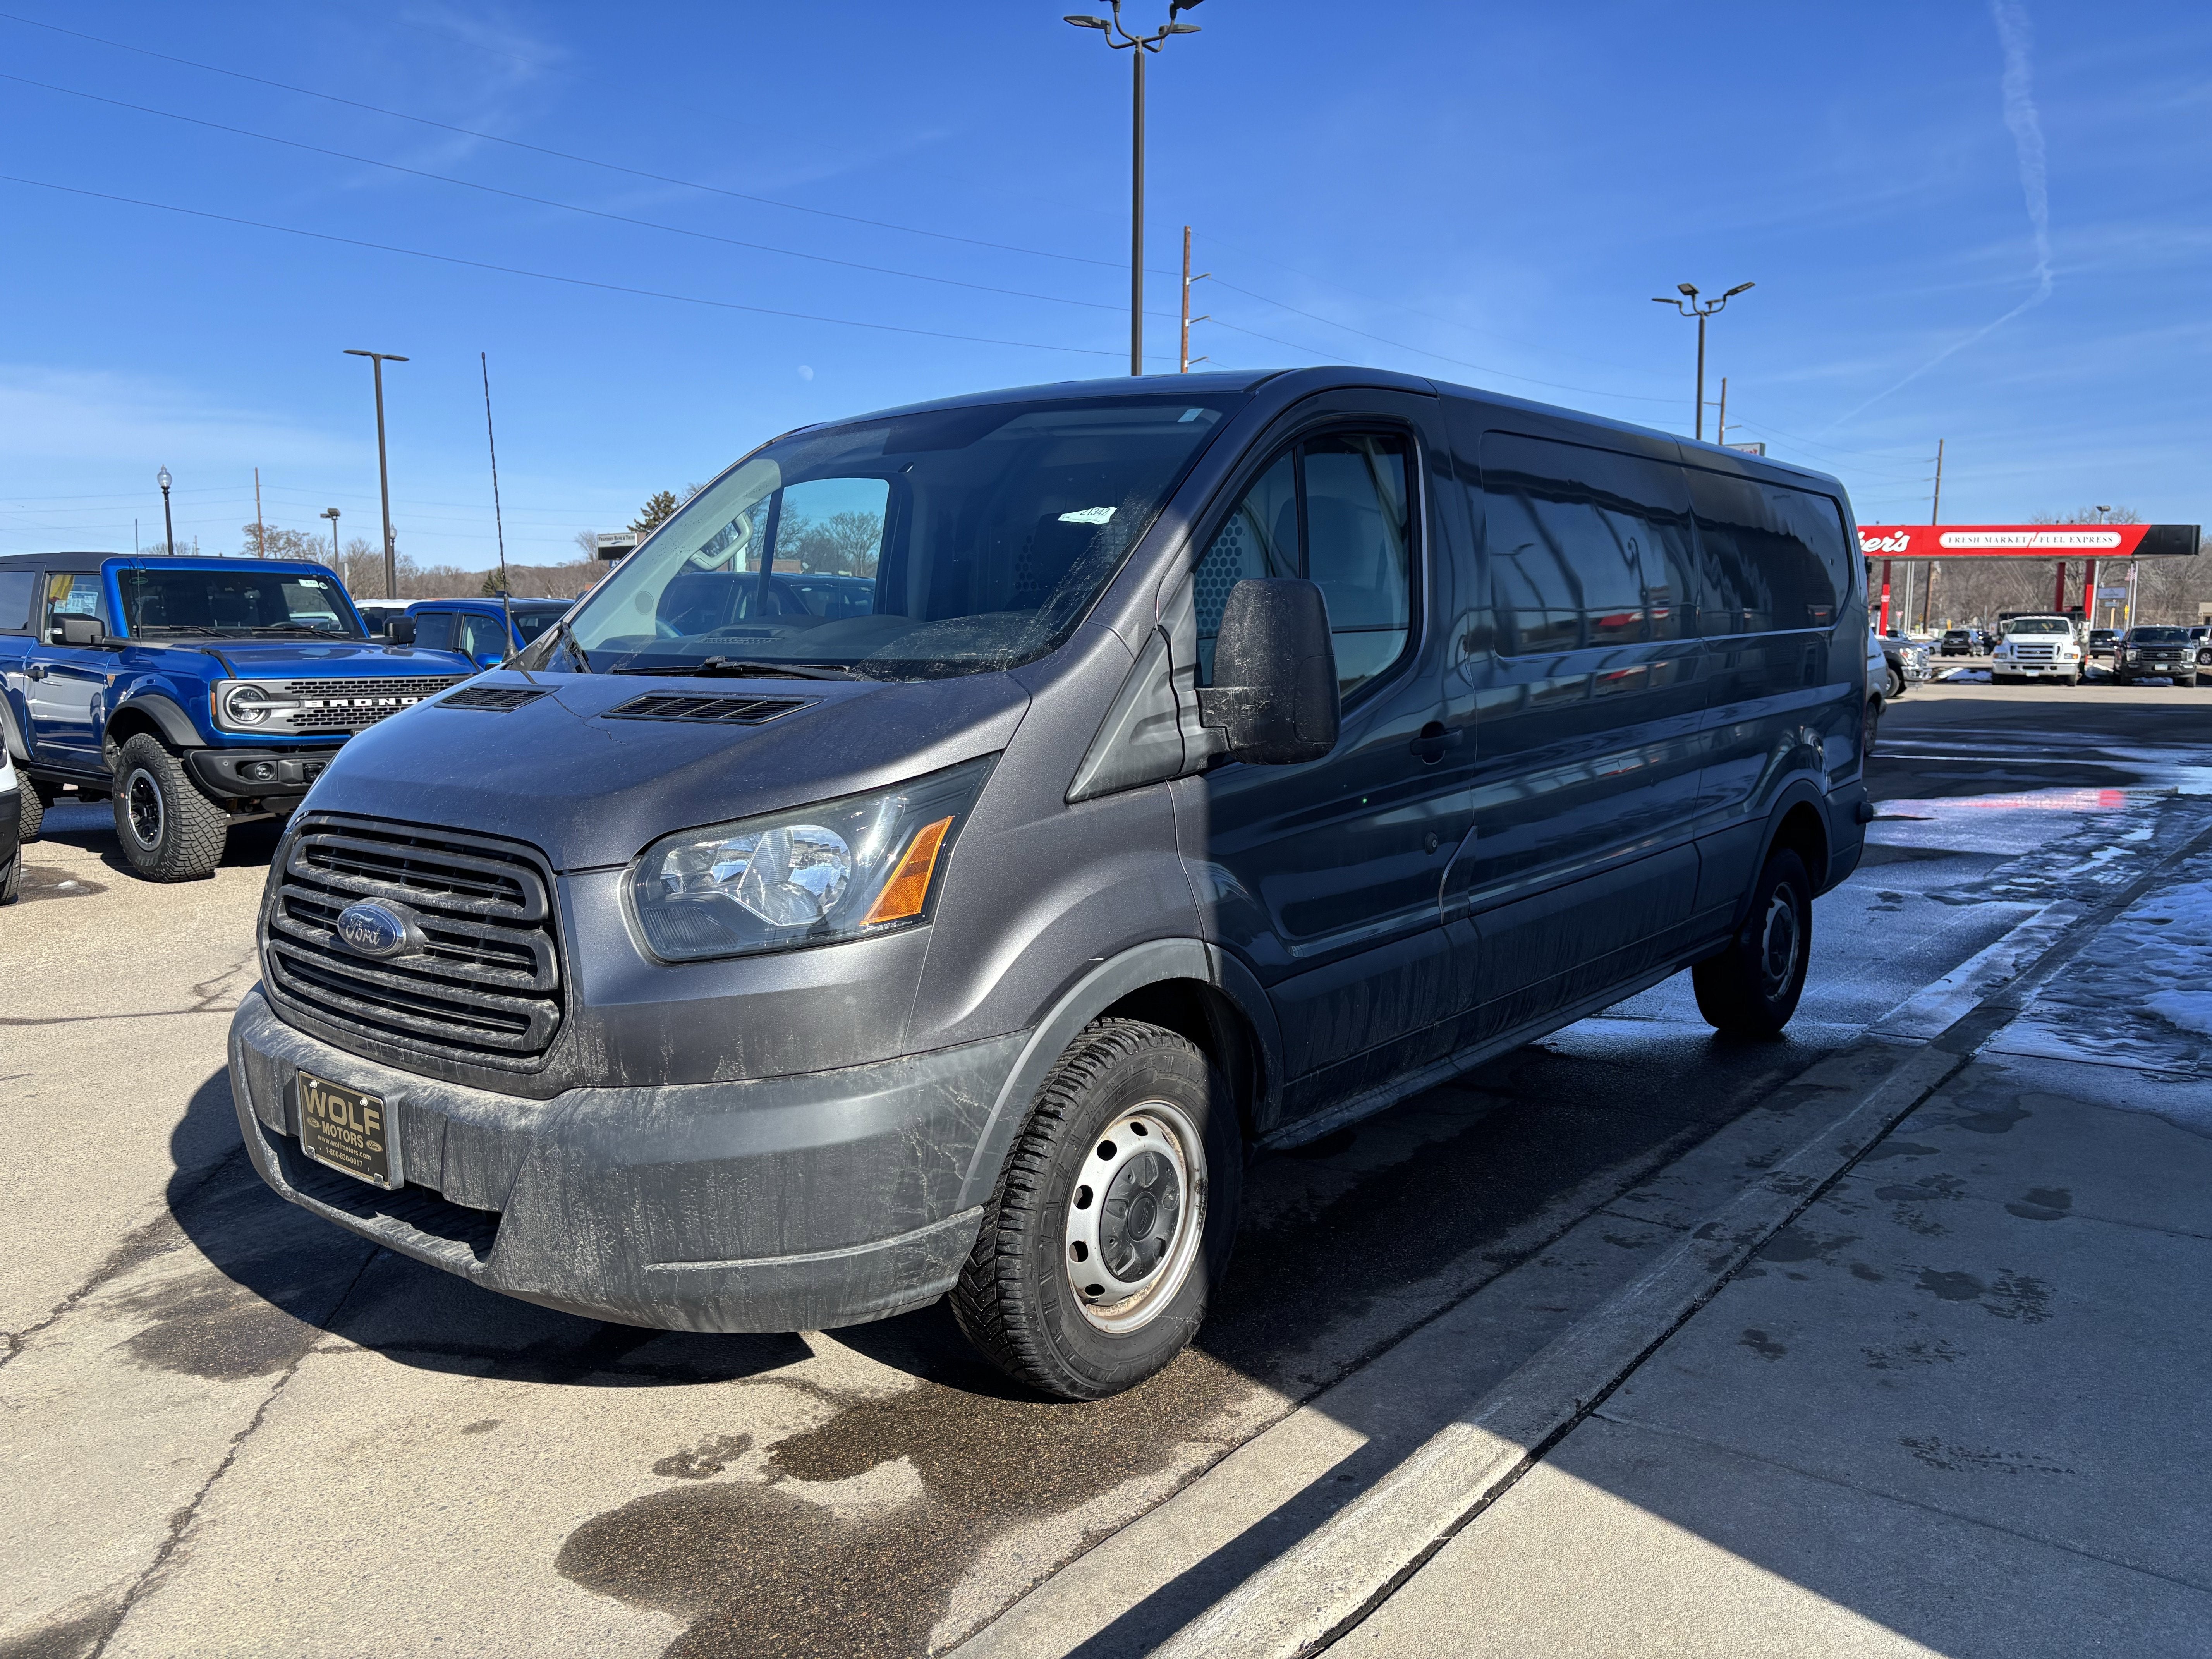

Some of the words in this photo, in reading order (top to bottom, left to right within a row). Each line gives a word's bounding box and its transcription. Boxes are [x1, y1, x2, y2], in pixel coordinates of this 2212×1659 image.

[305, 697, 427, 708] BRONC
[345, 913, 382, 945] Ford
[303, 1085, 380, 1135] WOLF
[322, 1121, 364, 1148] MOTORS
[318, 1135, 371, 1161] www.wolfmotors.com
[326, 1147, 363, 1167] 1-800-830-0017
